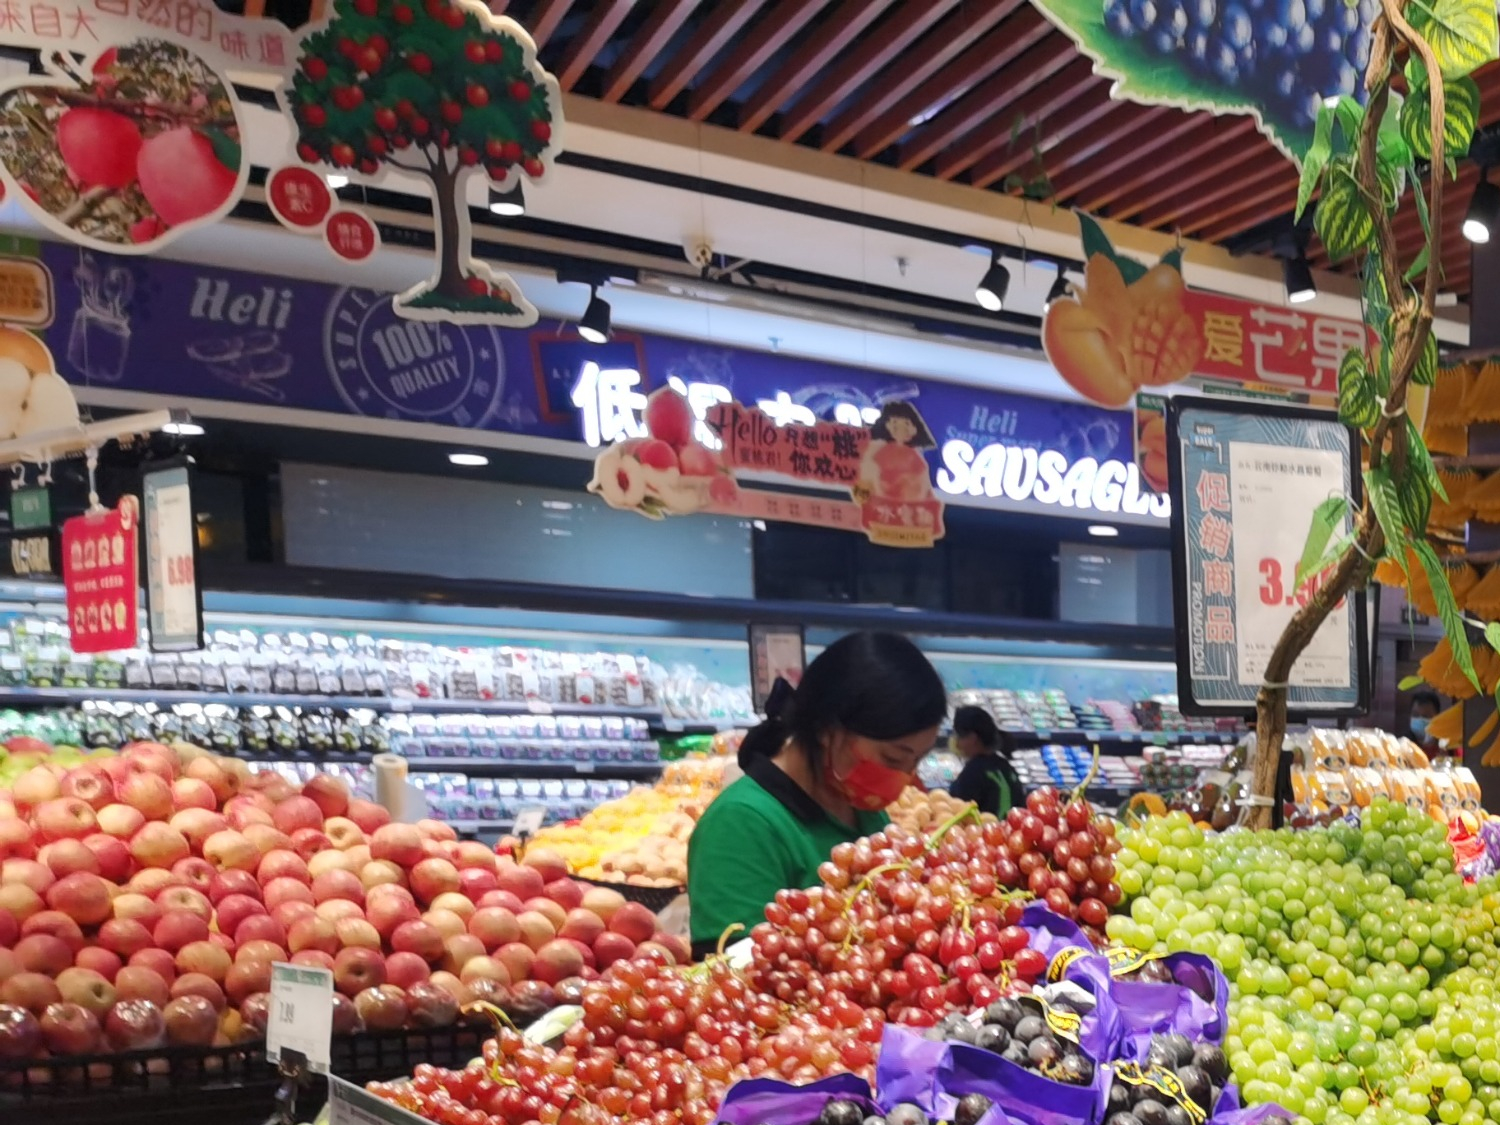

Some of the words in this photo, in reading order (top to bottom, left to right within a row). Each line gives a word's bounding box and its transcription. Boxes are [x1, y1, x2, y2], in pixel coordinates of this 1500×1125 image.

[190, 277, 293, 329] Heli
[372, 321, 452, 371] 100%
[1204, 306, 1368, 386] 爱芒果
[390, 356, 461, 399] QUALITY
[708, 406, 778, 464] Hello
[970, 405, 1019, 435] Heli
[1196, 469, 1236, 645] 促销商品
[1192, 581, 1206, 674] PROMOTION
